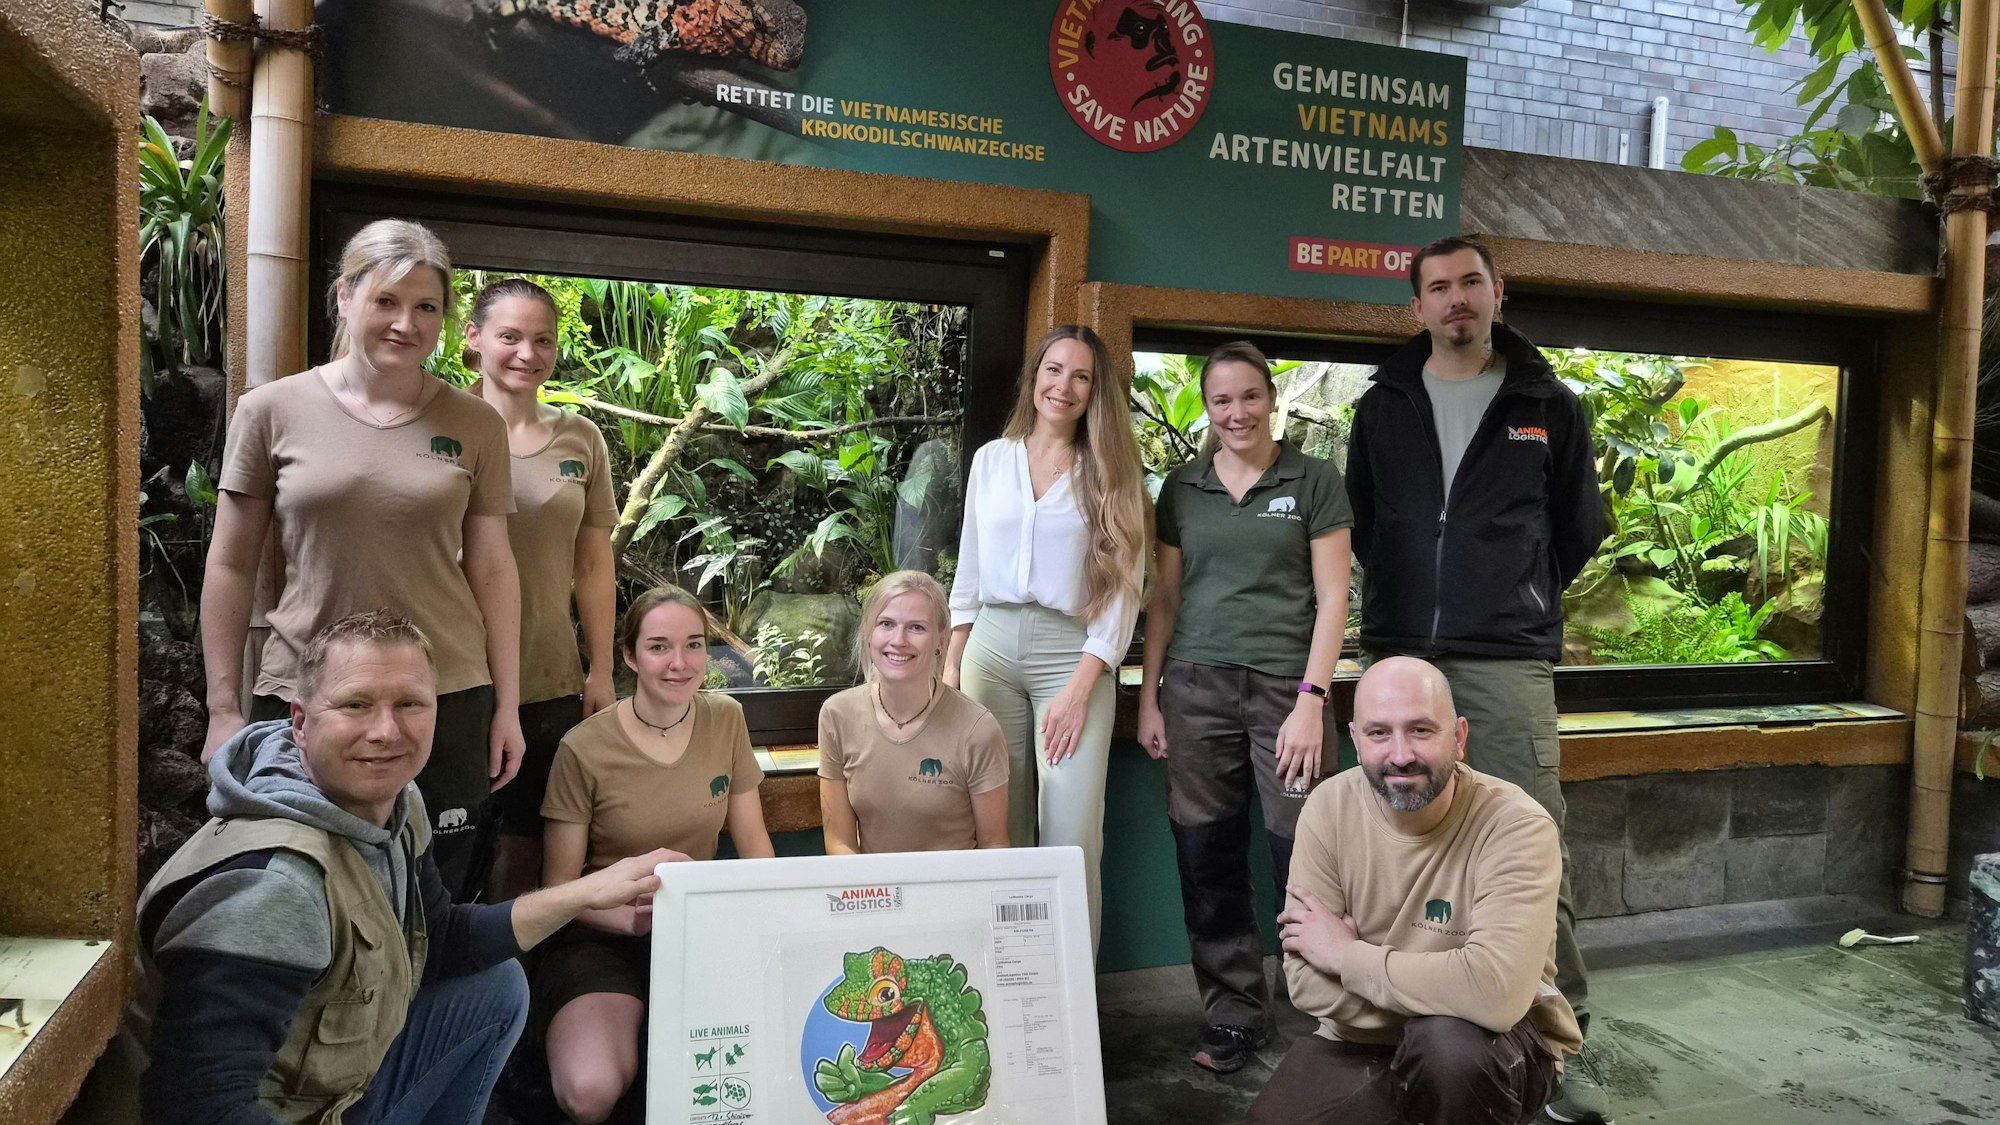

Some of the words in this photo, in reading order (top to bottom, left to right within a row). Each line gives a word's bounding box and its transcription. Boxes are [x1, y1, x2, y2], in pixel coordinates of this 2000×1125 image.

[1067, 83, 1126, 141] SAVE
[1133, 62, 1209, 144] NATURE
[1272, 62, 1450, 111] GEMEINSAM
[716, 83, 796, 110] RETTET
[801, 94, 834, 115] DIE
[840, 99, 1004, 135] VIETNAMESISCHE
[1297, 103, 1449, 147] VIETNAMS
[801, 118, 1046, 162] KROKODILSCHWANZECHSE
[1209, 132, 1447, 183] ARTENVIELFALT
[1331, 183, 1445, 220] RETTEN
[1296, 242, 1324, 265] BE
[1327, 245, 1382, 270] PART
[1383, 250, 1413, 272] OF
[830, 898, 892, 912] LOGISTICS
[841, 887, 891, 900] ANIMAL
[1444, 929, 1466, 937] ZOO
[690, 1028, 709, 1039] LIVE
[711, 1024, 750, 1036] ANIMALS
